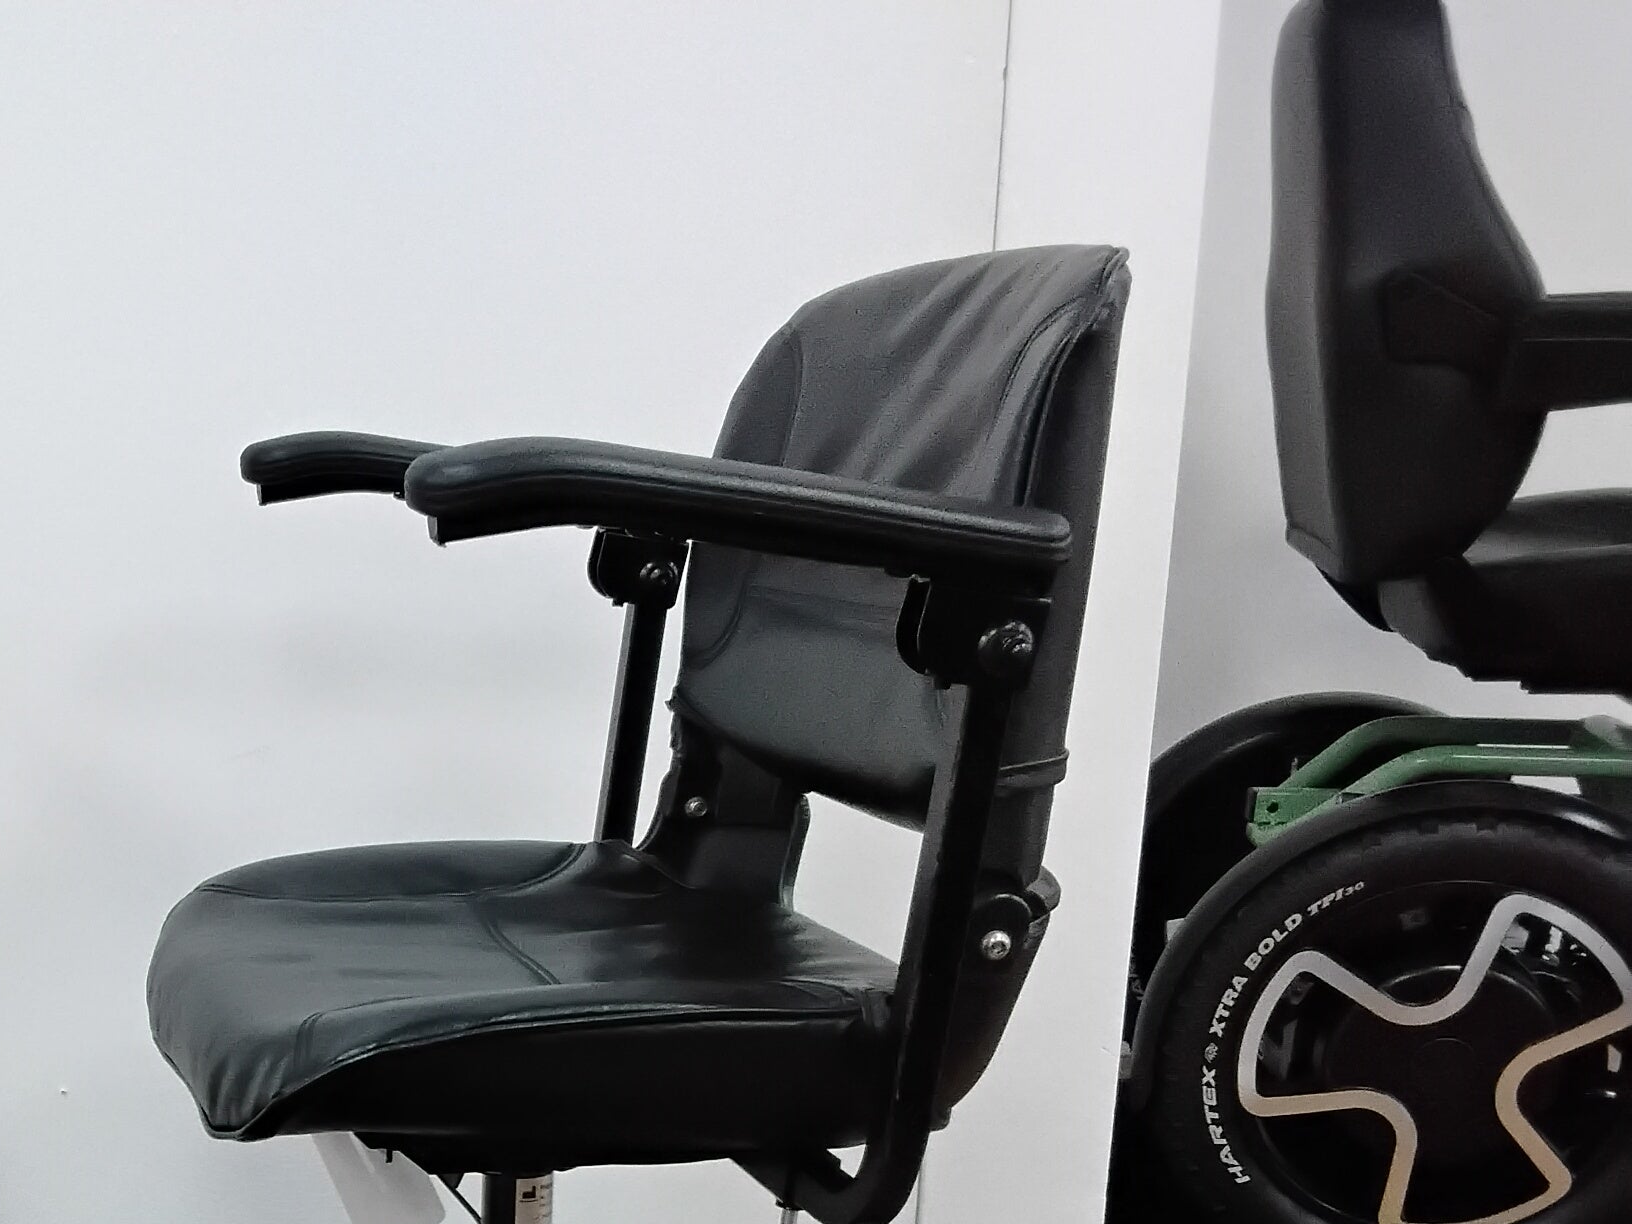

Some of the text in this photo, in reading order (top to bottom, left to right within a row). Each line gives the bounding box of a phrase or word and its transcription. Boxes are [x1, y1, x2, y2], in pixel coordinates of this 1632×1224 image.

[1243, 912, 1304, 972] BOLD
[1208, 976, 1249, 1038] XTRA
[1201, 1065, 1252, 1184] HARTEX
